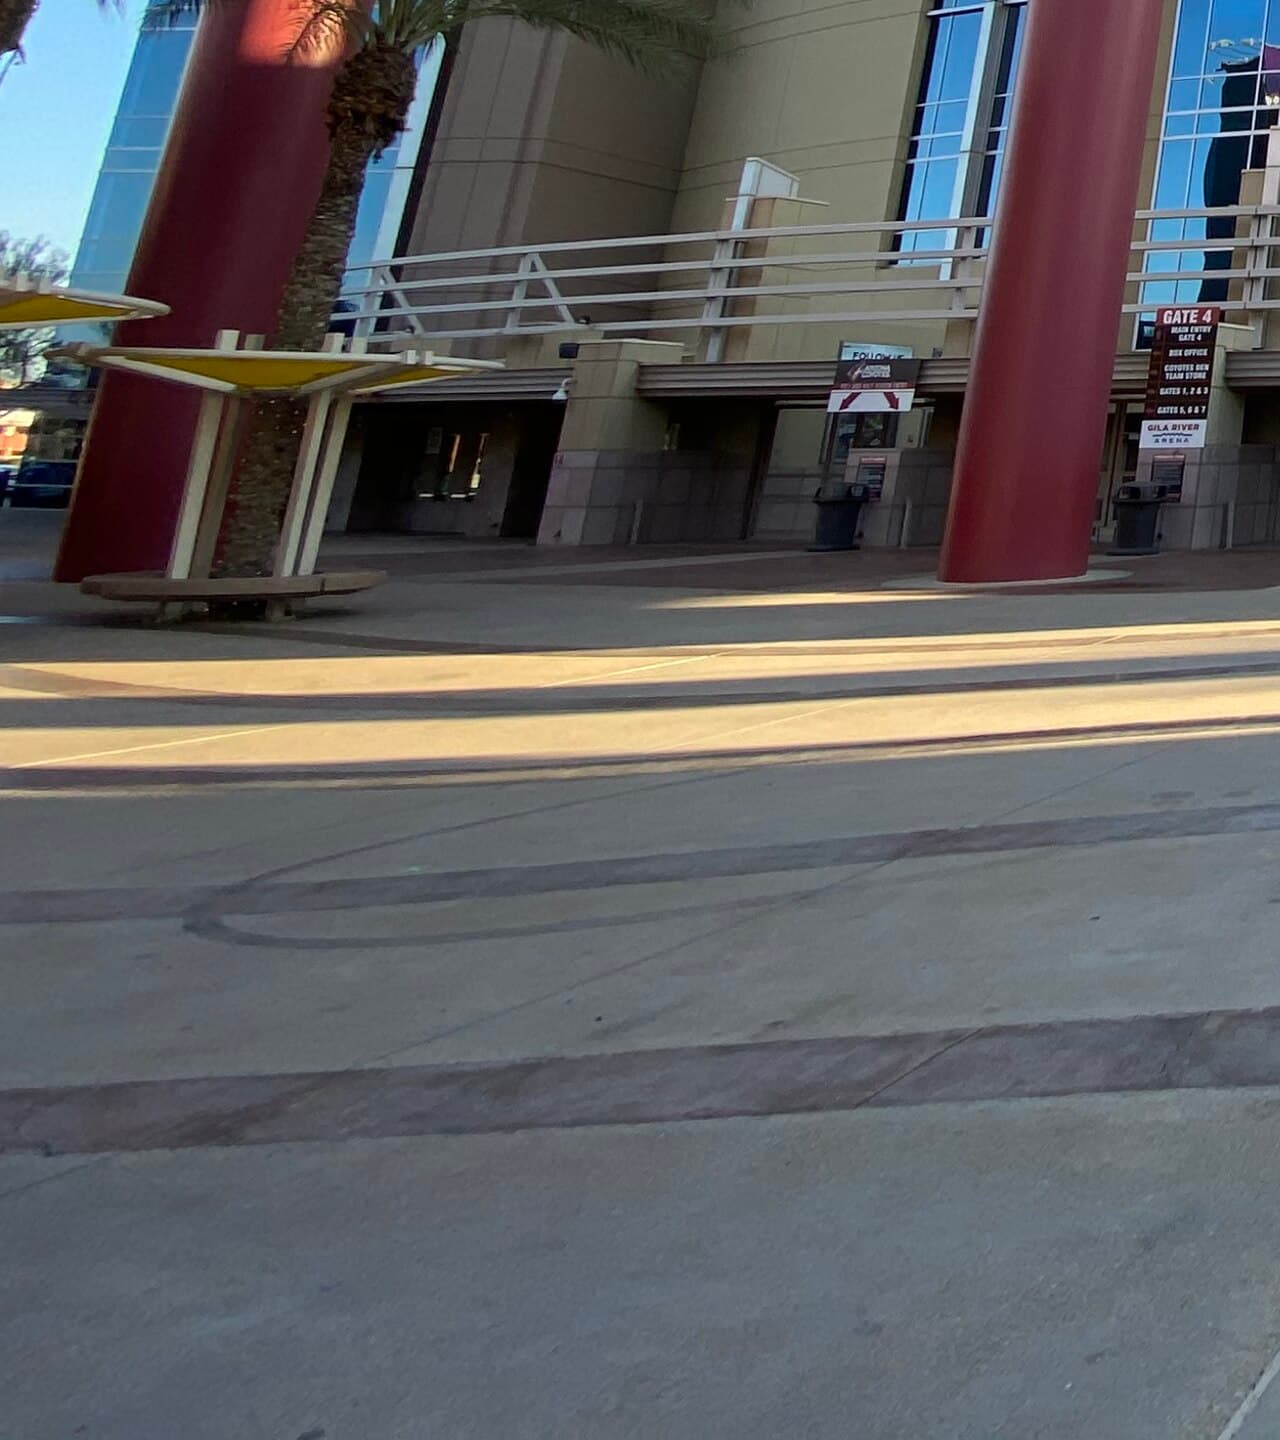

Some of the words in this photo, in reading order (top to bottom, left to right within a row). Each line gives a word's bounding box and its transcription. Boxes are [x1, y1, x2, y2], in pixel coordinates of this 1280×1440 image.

[1163, 309, 1200, 324] GATE
[1202, 309, 1212, 323] 4
[1171, 423, 1200, 431] RIVER
